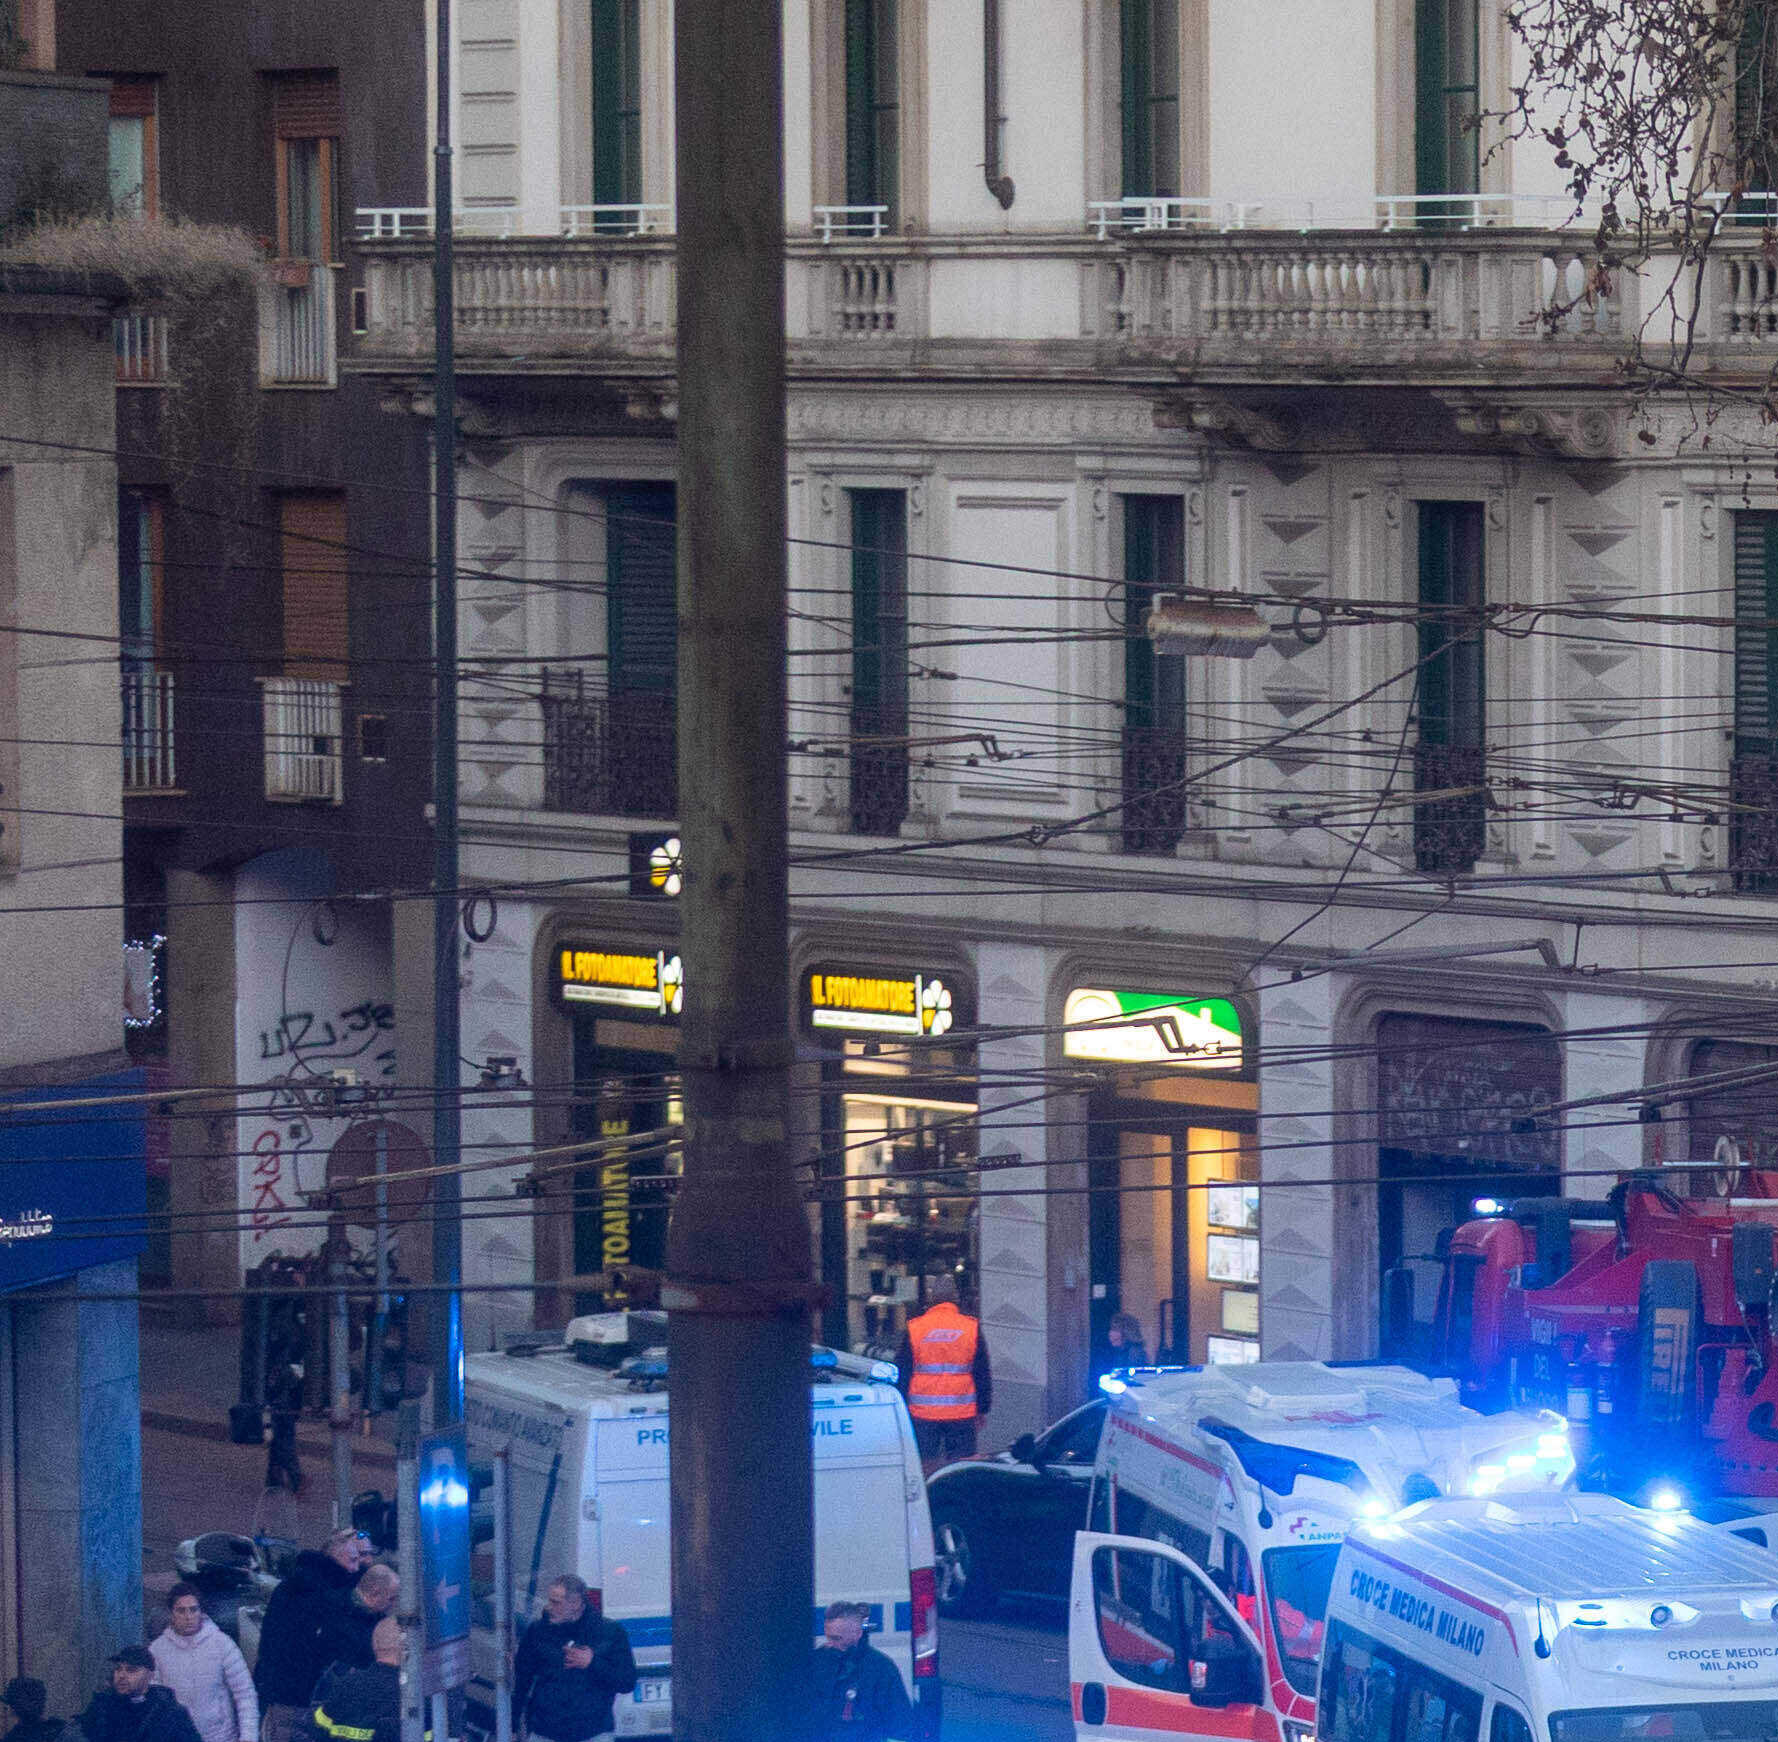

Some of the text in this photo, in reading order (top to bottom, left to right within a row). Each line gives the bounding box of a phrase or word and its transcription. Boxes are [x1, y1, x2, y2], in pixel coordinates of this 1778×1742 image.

[575, 952, 657, 988] FOTOAMATORE
[826, 976, 915, 1013] FOTOAMATORE
[1350, 1570, 1485, 1657] CROCE MEDICA MILANO
[1667, 1650, 1721, 1662] CROCE
[1700, 1660, 1758, 1673] MILANO
